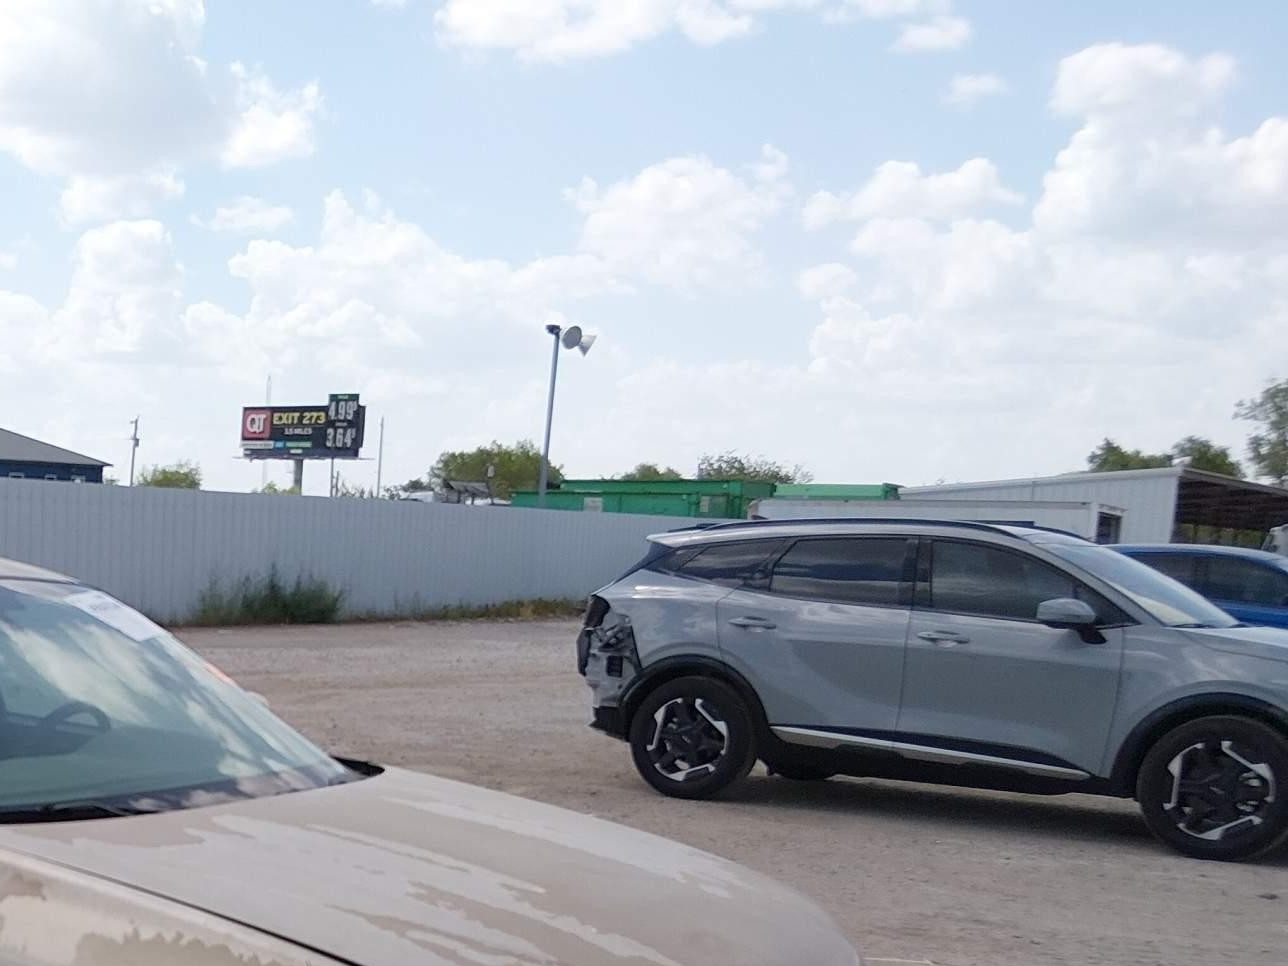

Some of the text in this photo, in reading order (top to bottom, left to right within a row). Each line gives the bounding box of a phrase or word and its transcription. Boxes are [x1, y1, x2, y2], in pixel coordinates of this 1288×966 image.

[246, 414, 266, 433] QT
[273, 411, 326, 425] EXIT 273
